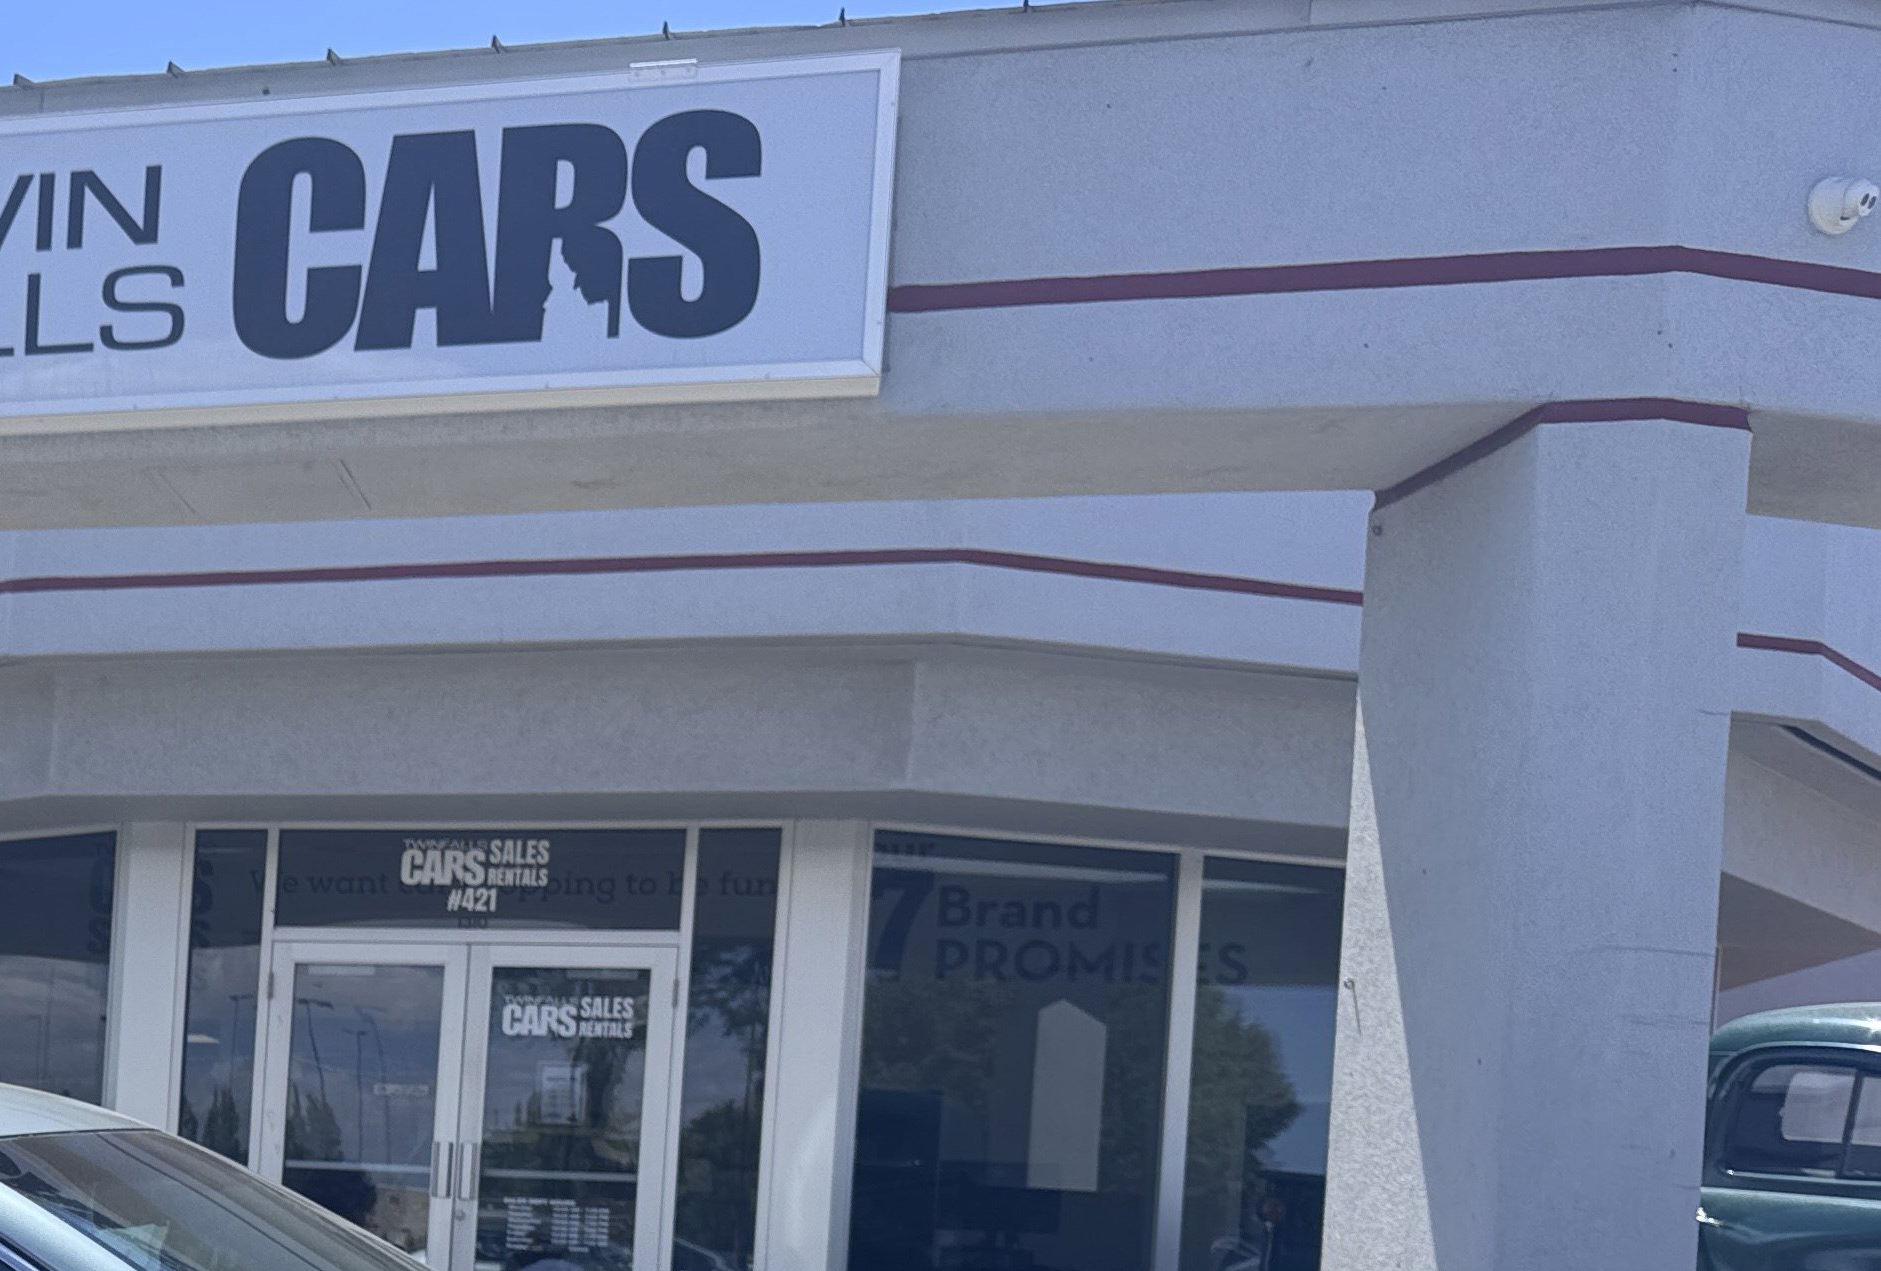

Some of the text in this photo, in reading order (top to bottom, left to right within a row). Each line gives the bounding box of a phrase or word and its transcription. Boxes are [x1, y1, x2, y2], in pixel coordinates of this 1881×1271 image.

[233, 109, 762, 359] CARS
[489, 839, 551, 865] SALES
[400, 849, 487, 886] CARS
[487, 867, 549, 887] RENTALS
[307, 873, 389, 895] want
[626, 873, 657, 896] to
[447, 888, 497, 912] #421
[936, 883, 1101, 929] Brand
[580, 997, 634, 1018] SALES
[502, 1004, 578, 1037] CARS
[579, 1020, 633, 1038] RENTALS
